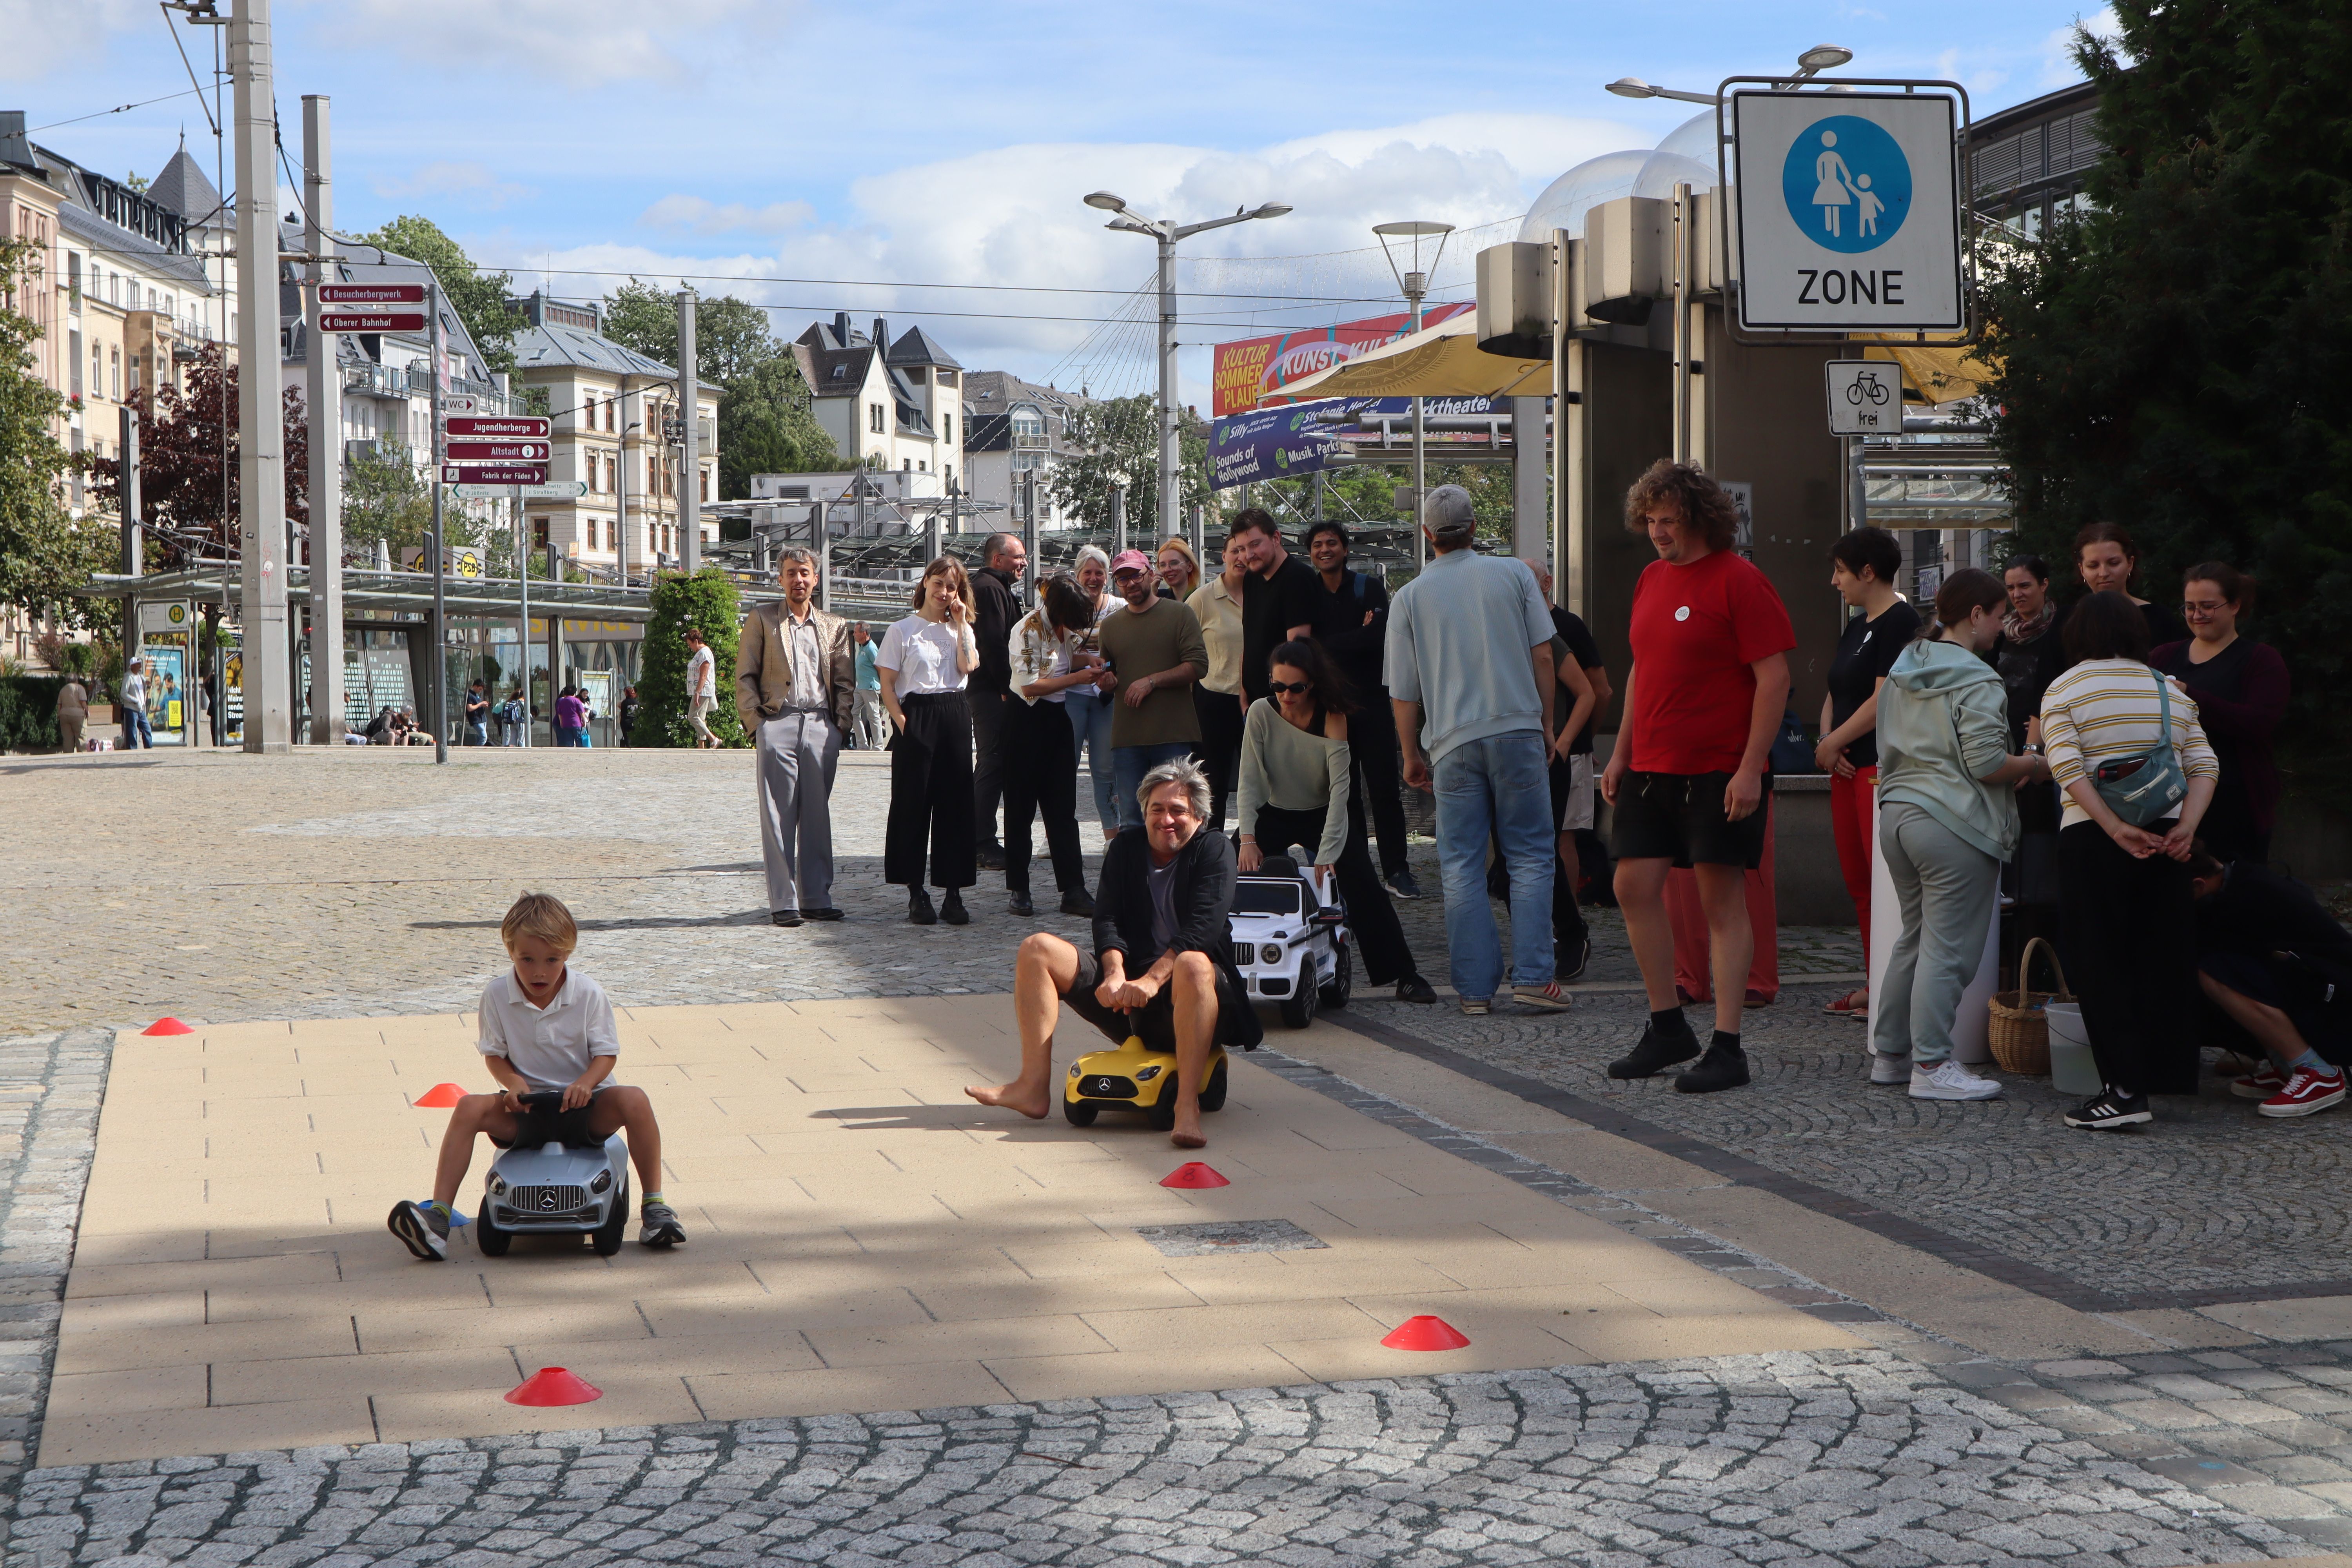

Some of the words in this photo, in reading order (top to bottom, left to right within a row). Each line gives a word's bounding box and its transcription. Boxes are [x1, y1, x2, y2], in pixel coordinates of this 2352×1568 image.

[333, 289, 402, 299] Besucherbergwerk
[1797, 269, 1904, 305] ZONE
[334, 318, 358, 327] Oberer
[361, 318, 392, 327] Bahnhof
[1221, 344, 1270, 370] KULTUR
[1215, 363, 1263, 391] SOMMER
[448, 400, 464, 409] WC
[1405, 396, 1491, 414] Prktheater
[1858, 410, 1878, 426] frei
[473, 422, 530, 434] Jugendherberge
[1229, 423, 1249, 439] Silly
[491, 446, 519, 456] Altstadt
[1216, 448, 1243, 469] Sounds
[1245, 443, 1255, 459] of
[1288, 445, 1316, 463] Musik.
[1217, 457, 1260, 483] Hollywood
[463, 562, 475, 572] PSB
